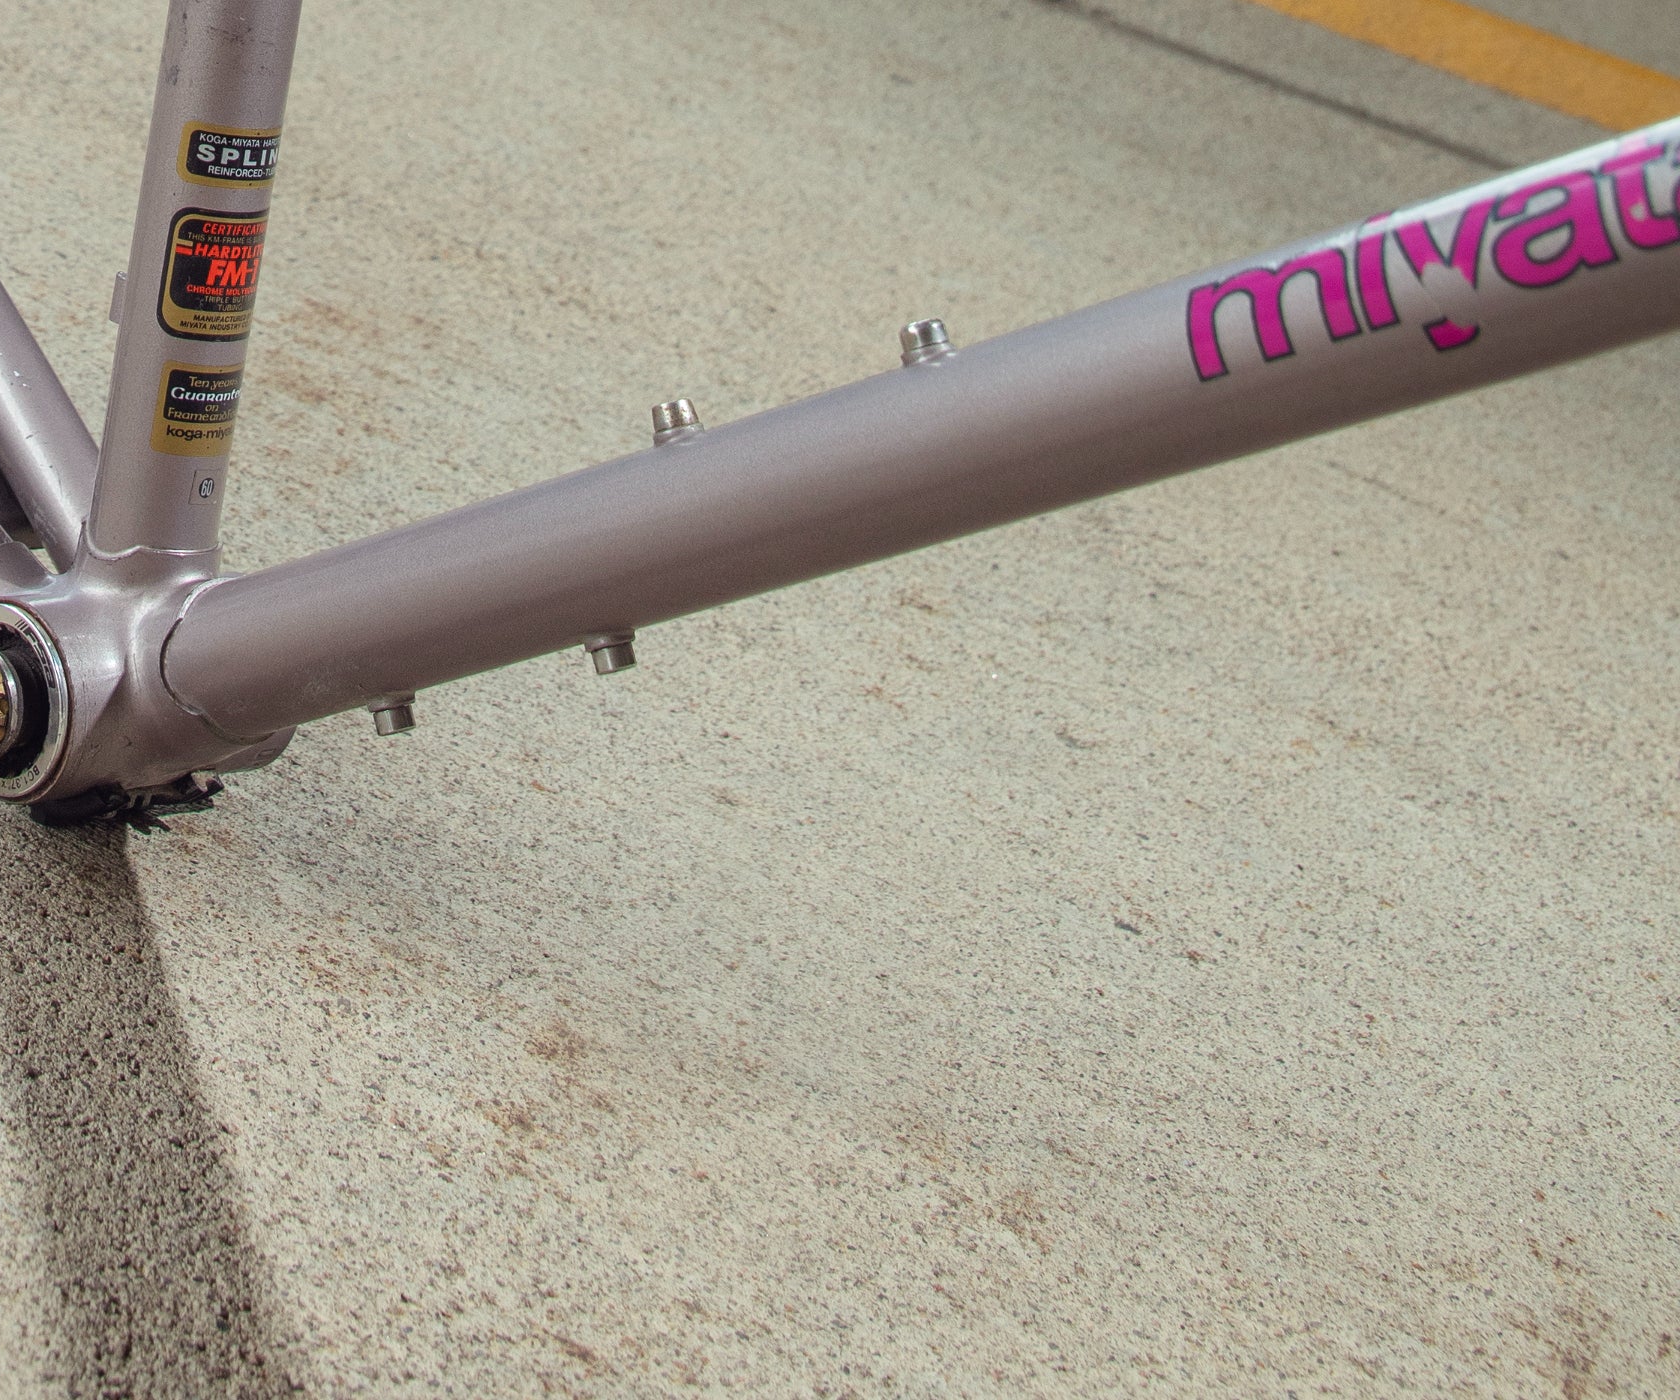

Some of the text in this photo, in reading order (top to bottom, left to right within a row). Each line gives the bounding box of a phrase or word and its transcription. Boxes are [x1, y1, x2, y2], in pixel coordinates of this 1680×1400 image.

[188, 231, 205, 241] THIS
[1186, 134, 1680, 382] miyat
[186, 284, 224, 296] CHROME
[180, 320, 207, 330] MIYATA
[189, 375, 210, 388] Ten
[205, 404, 219, 412] on
[201, 479, 214, 496] 60
